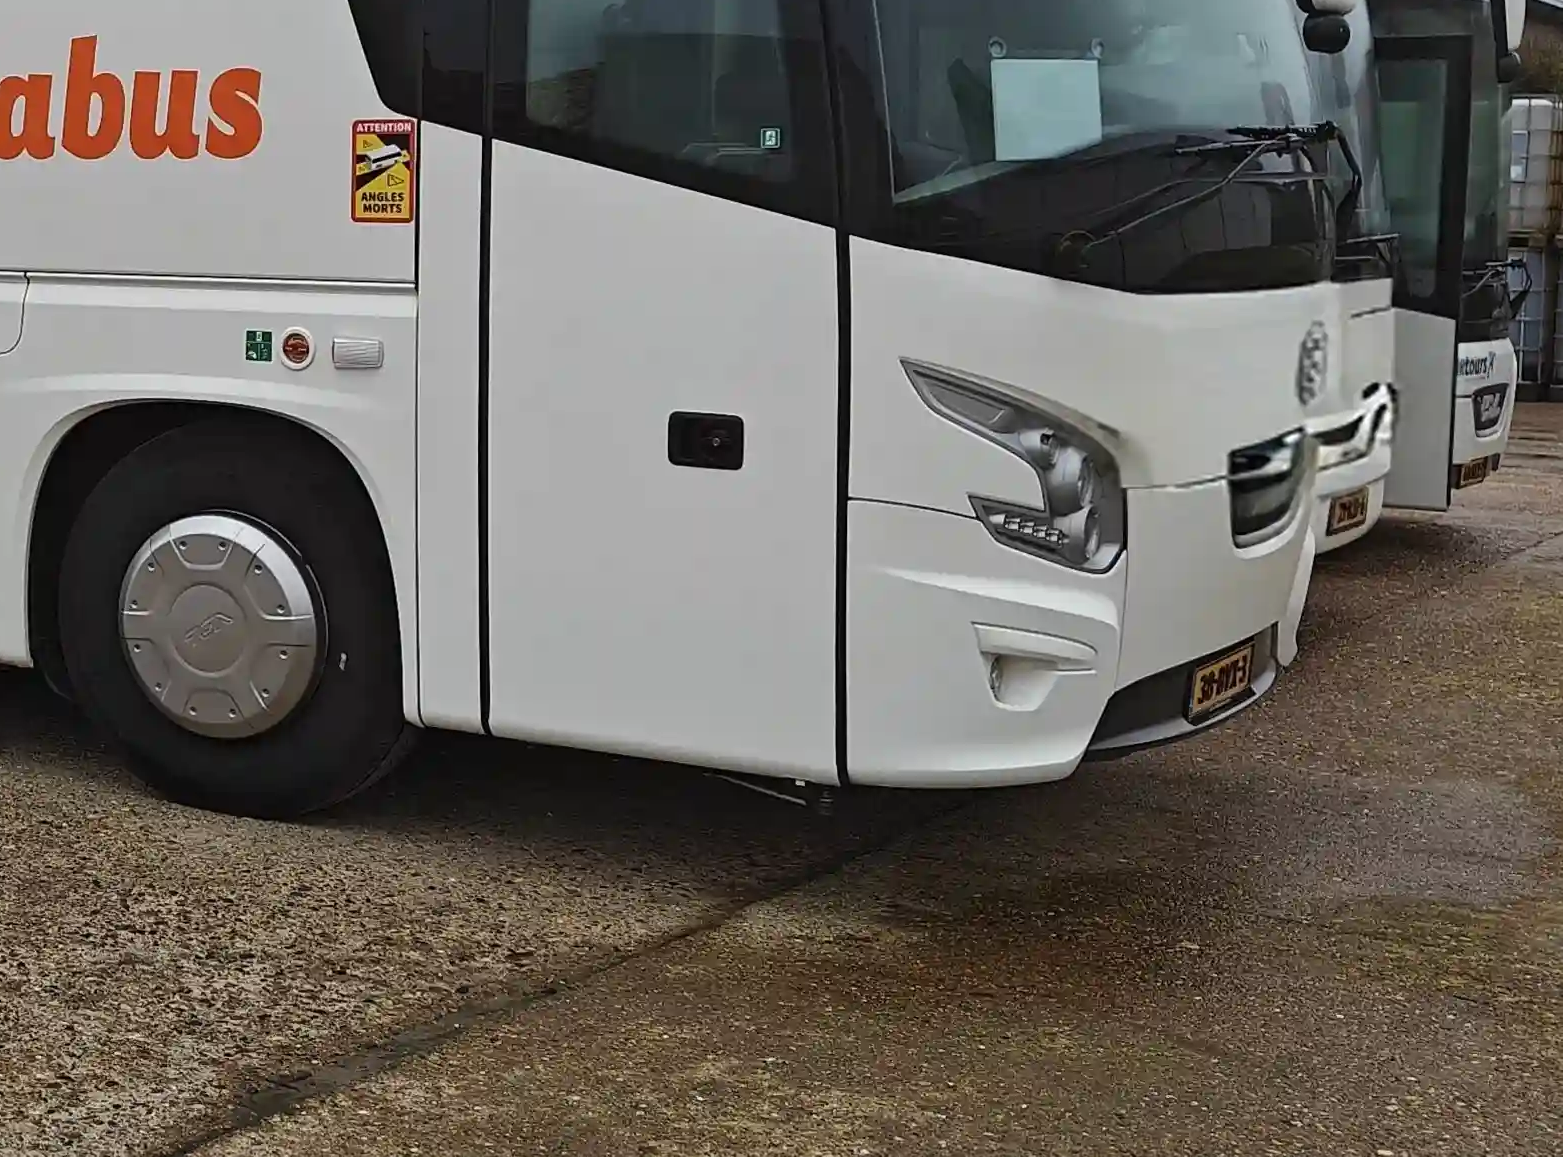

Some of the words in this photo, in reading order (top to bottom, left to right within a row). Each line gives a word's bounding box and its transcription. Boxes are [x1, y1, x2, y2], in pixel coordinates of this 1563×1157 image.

[357, 123, 412, 132] ATTENTION
[361, 192, 405, 202] ANGLES
[363, 203, 403, 214] MORTS
